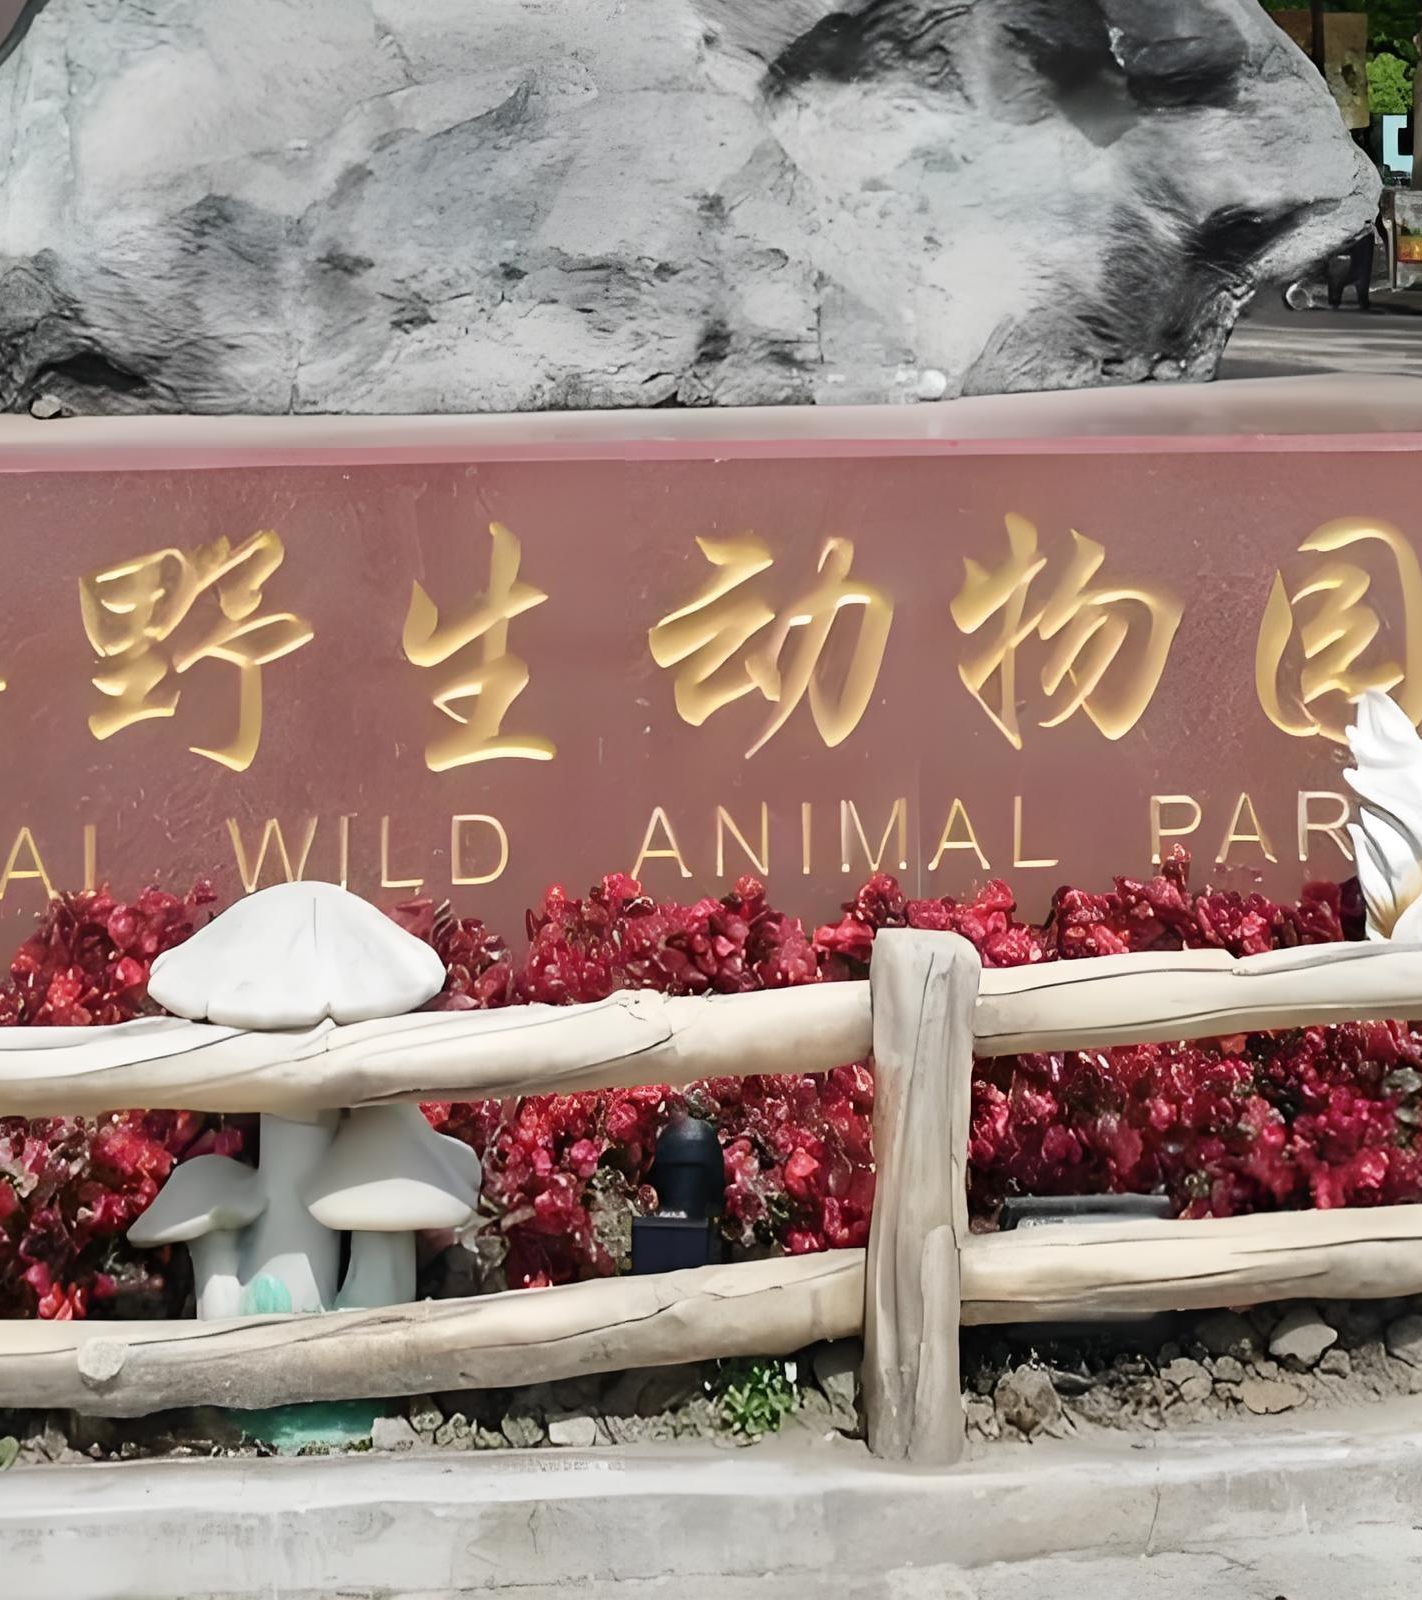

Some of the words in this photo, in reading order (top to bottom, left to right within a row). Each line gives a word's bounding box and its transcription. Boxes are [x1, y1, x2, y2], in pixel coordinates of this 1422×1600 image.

[226, 814, 510, 893] WILD
[632, 796, 1060, 879] ANIMAL
[1150, 790, 1355, 863] PAR
